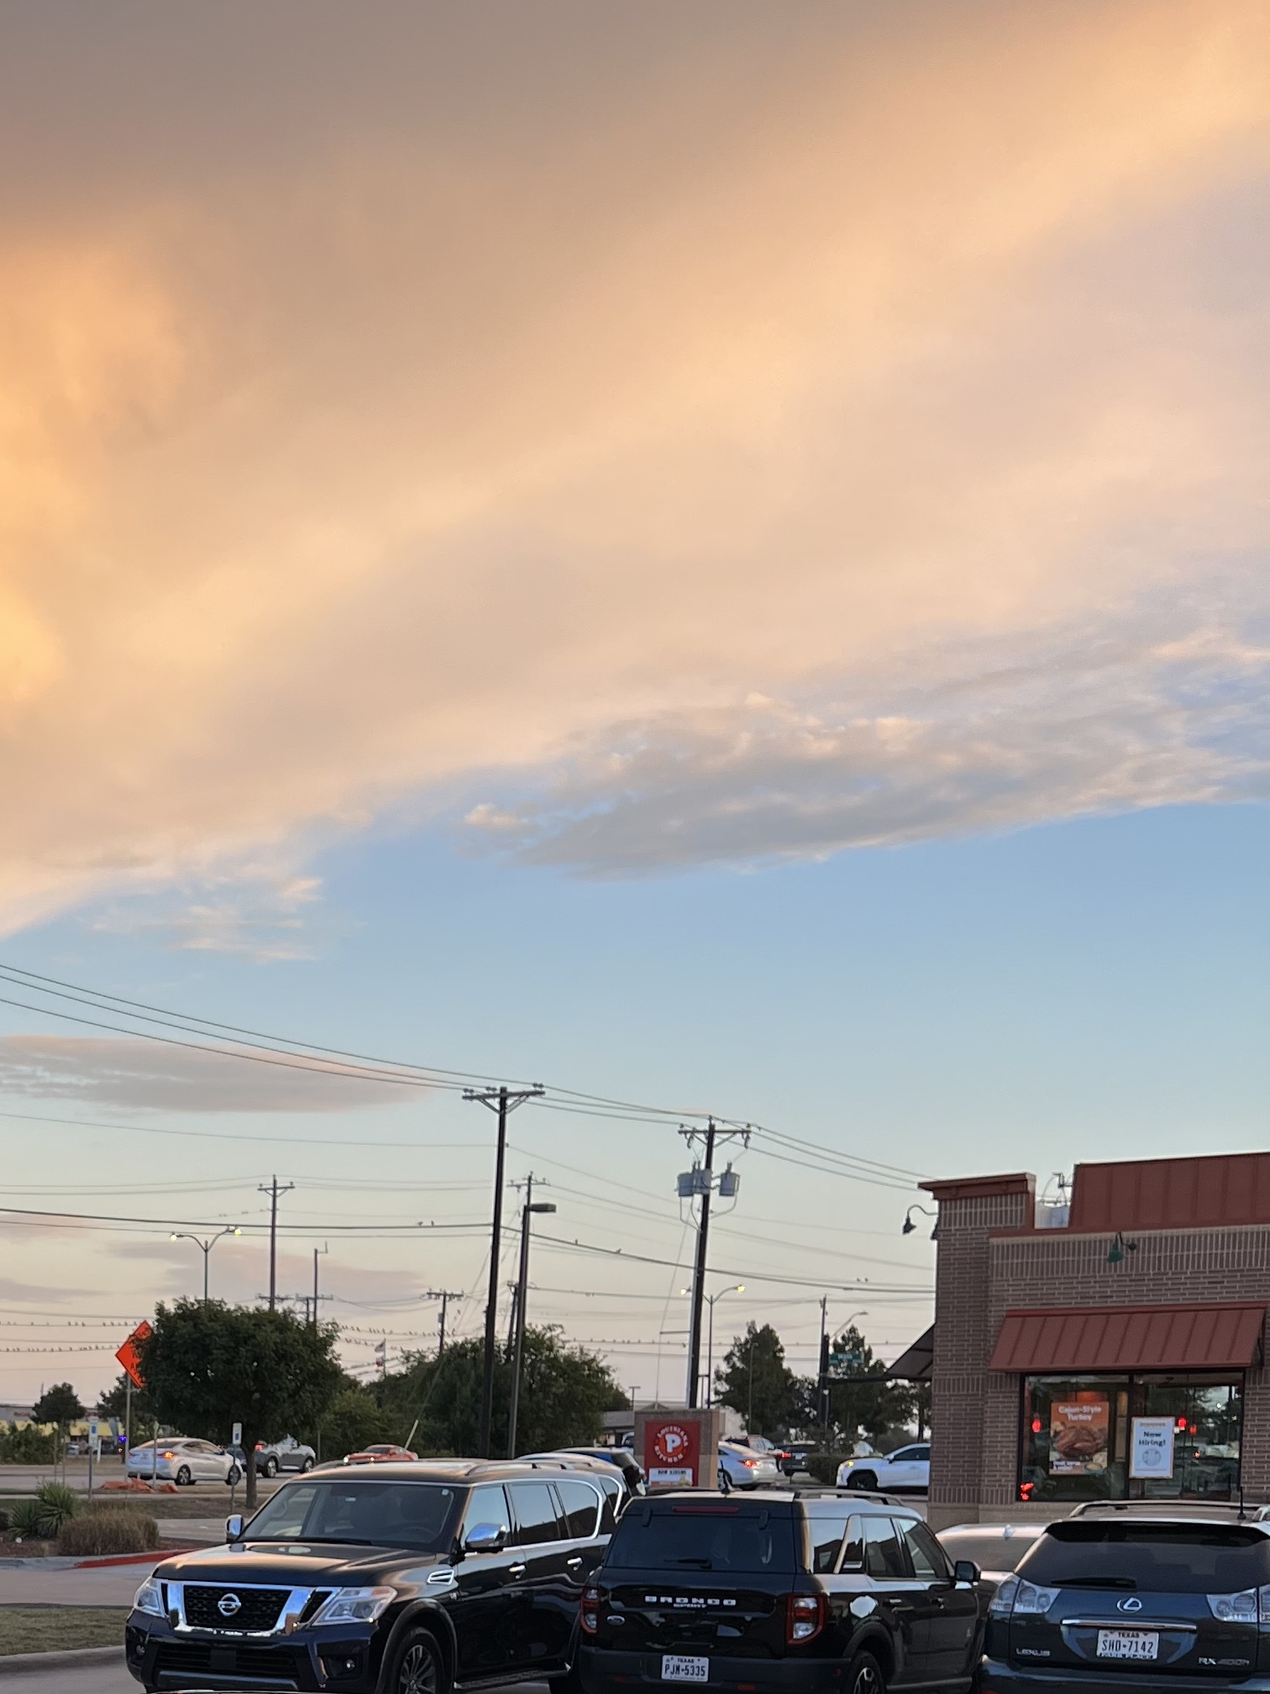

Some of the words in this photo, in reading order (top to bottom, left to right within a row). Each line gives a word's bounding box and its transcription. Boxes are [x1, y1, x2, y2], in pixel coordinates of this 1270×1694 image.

[664, 1433, 682, 1454] P
[1138, 1438, 1166, 1448] Hiring!
[644, 1595, 737, 1606] BRONCO
